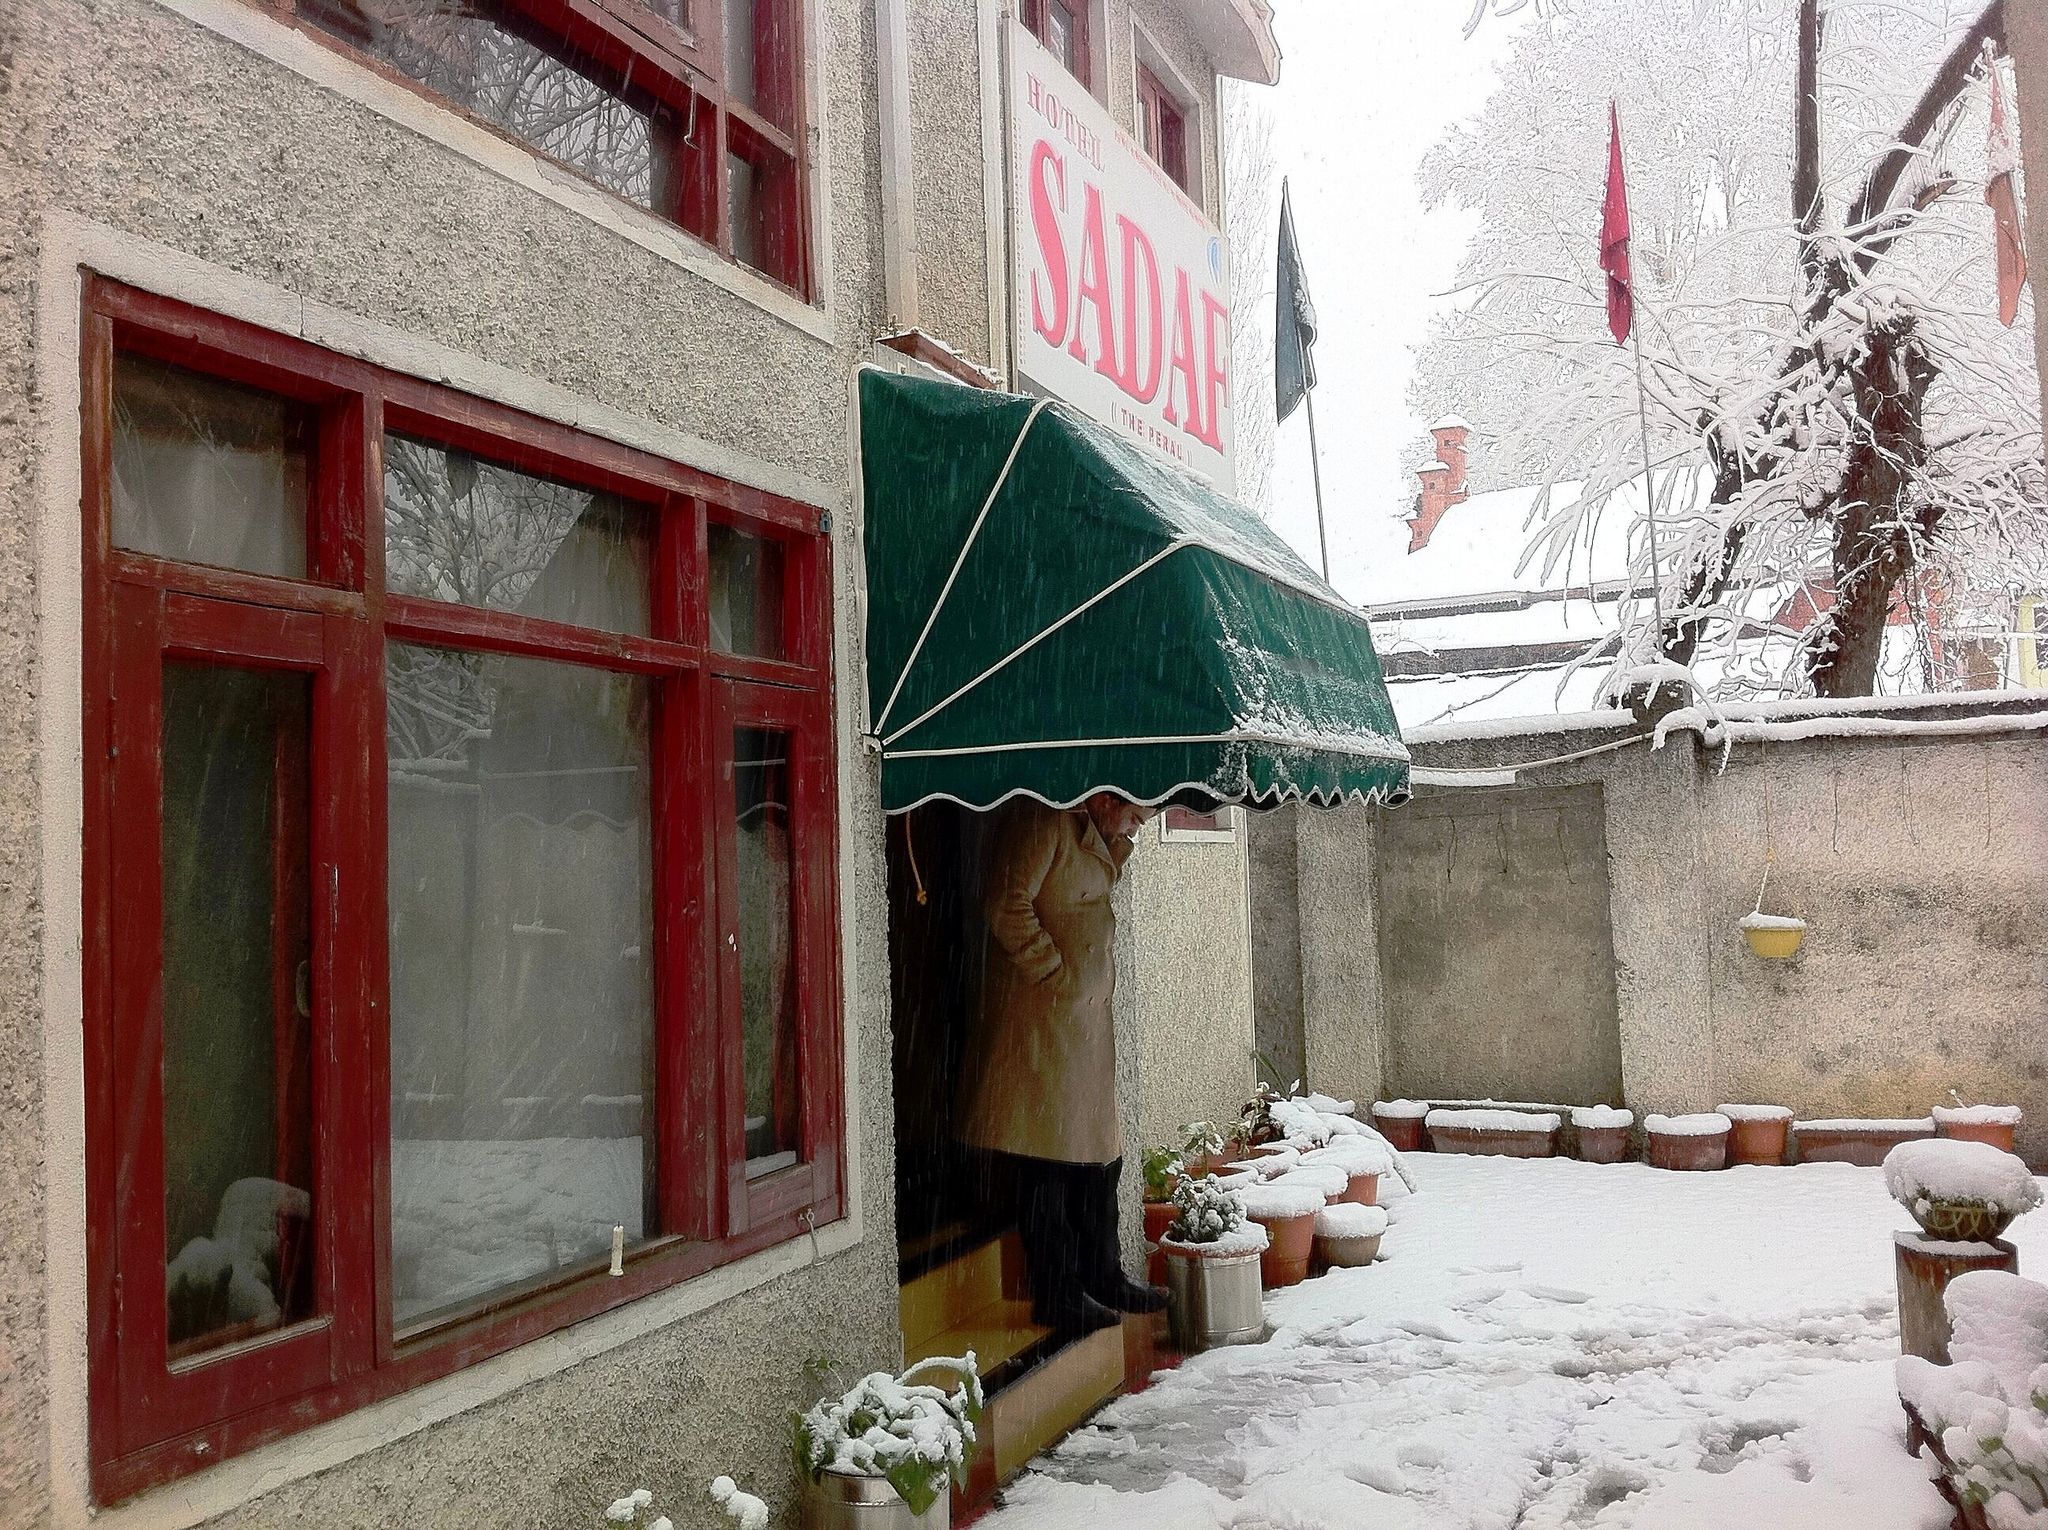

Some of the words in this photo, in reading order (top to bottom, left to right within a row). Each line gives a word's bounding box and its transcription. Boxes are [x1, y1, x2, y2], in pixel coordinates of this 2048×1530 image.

[1026, 71, 1104, 173] HOTEL
[1030, 138, 1230, 454] SADAF
[1121, 408, 1143, 436] THE
[1148, 425, 1182, 460] PERAL
